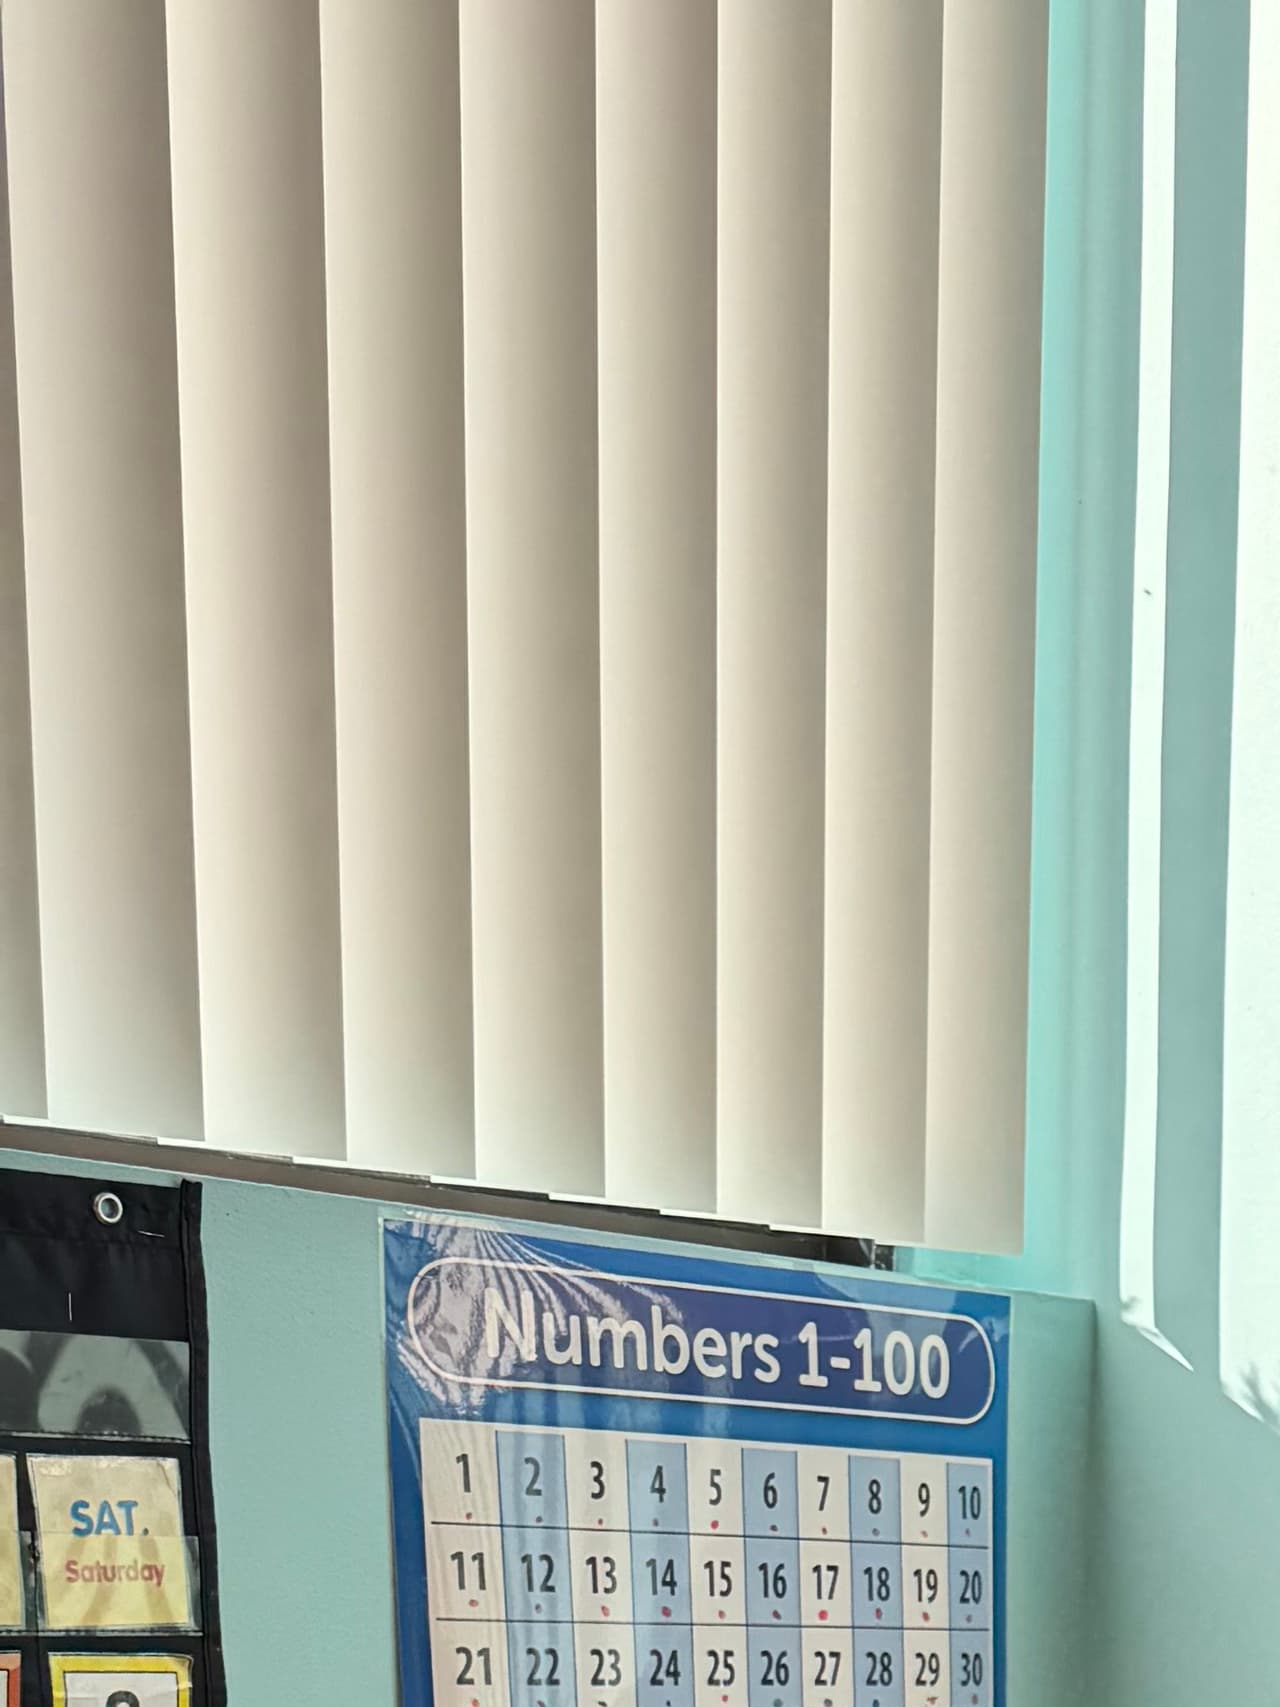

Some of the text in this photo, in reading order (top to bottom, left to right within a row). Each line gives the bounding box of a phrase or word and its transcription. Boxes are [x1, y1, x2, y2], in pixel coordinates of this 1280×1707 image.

[482, 1287, 950, 1400] Numbers 1-100
[455, 1453, 981, 1521] 1 2 3 4 5 6 7 8 9 10
[70, 1499, 149, 1538] SAT.
[65, 1558, 165, 1587] Saturday
[450, 1551, 982, 1605] 11 12 13 14 15 16 17 18 19 20
[455, 1646, 983, 1687] 21 22 23 24 25 26 27 28 29 30
